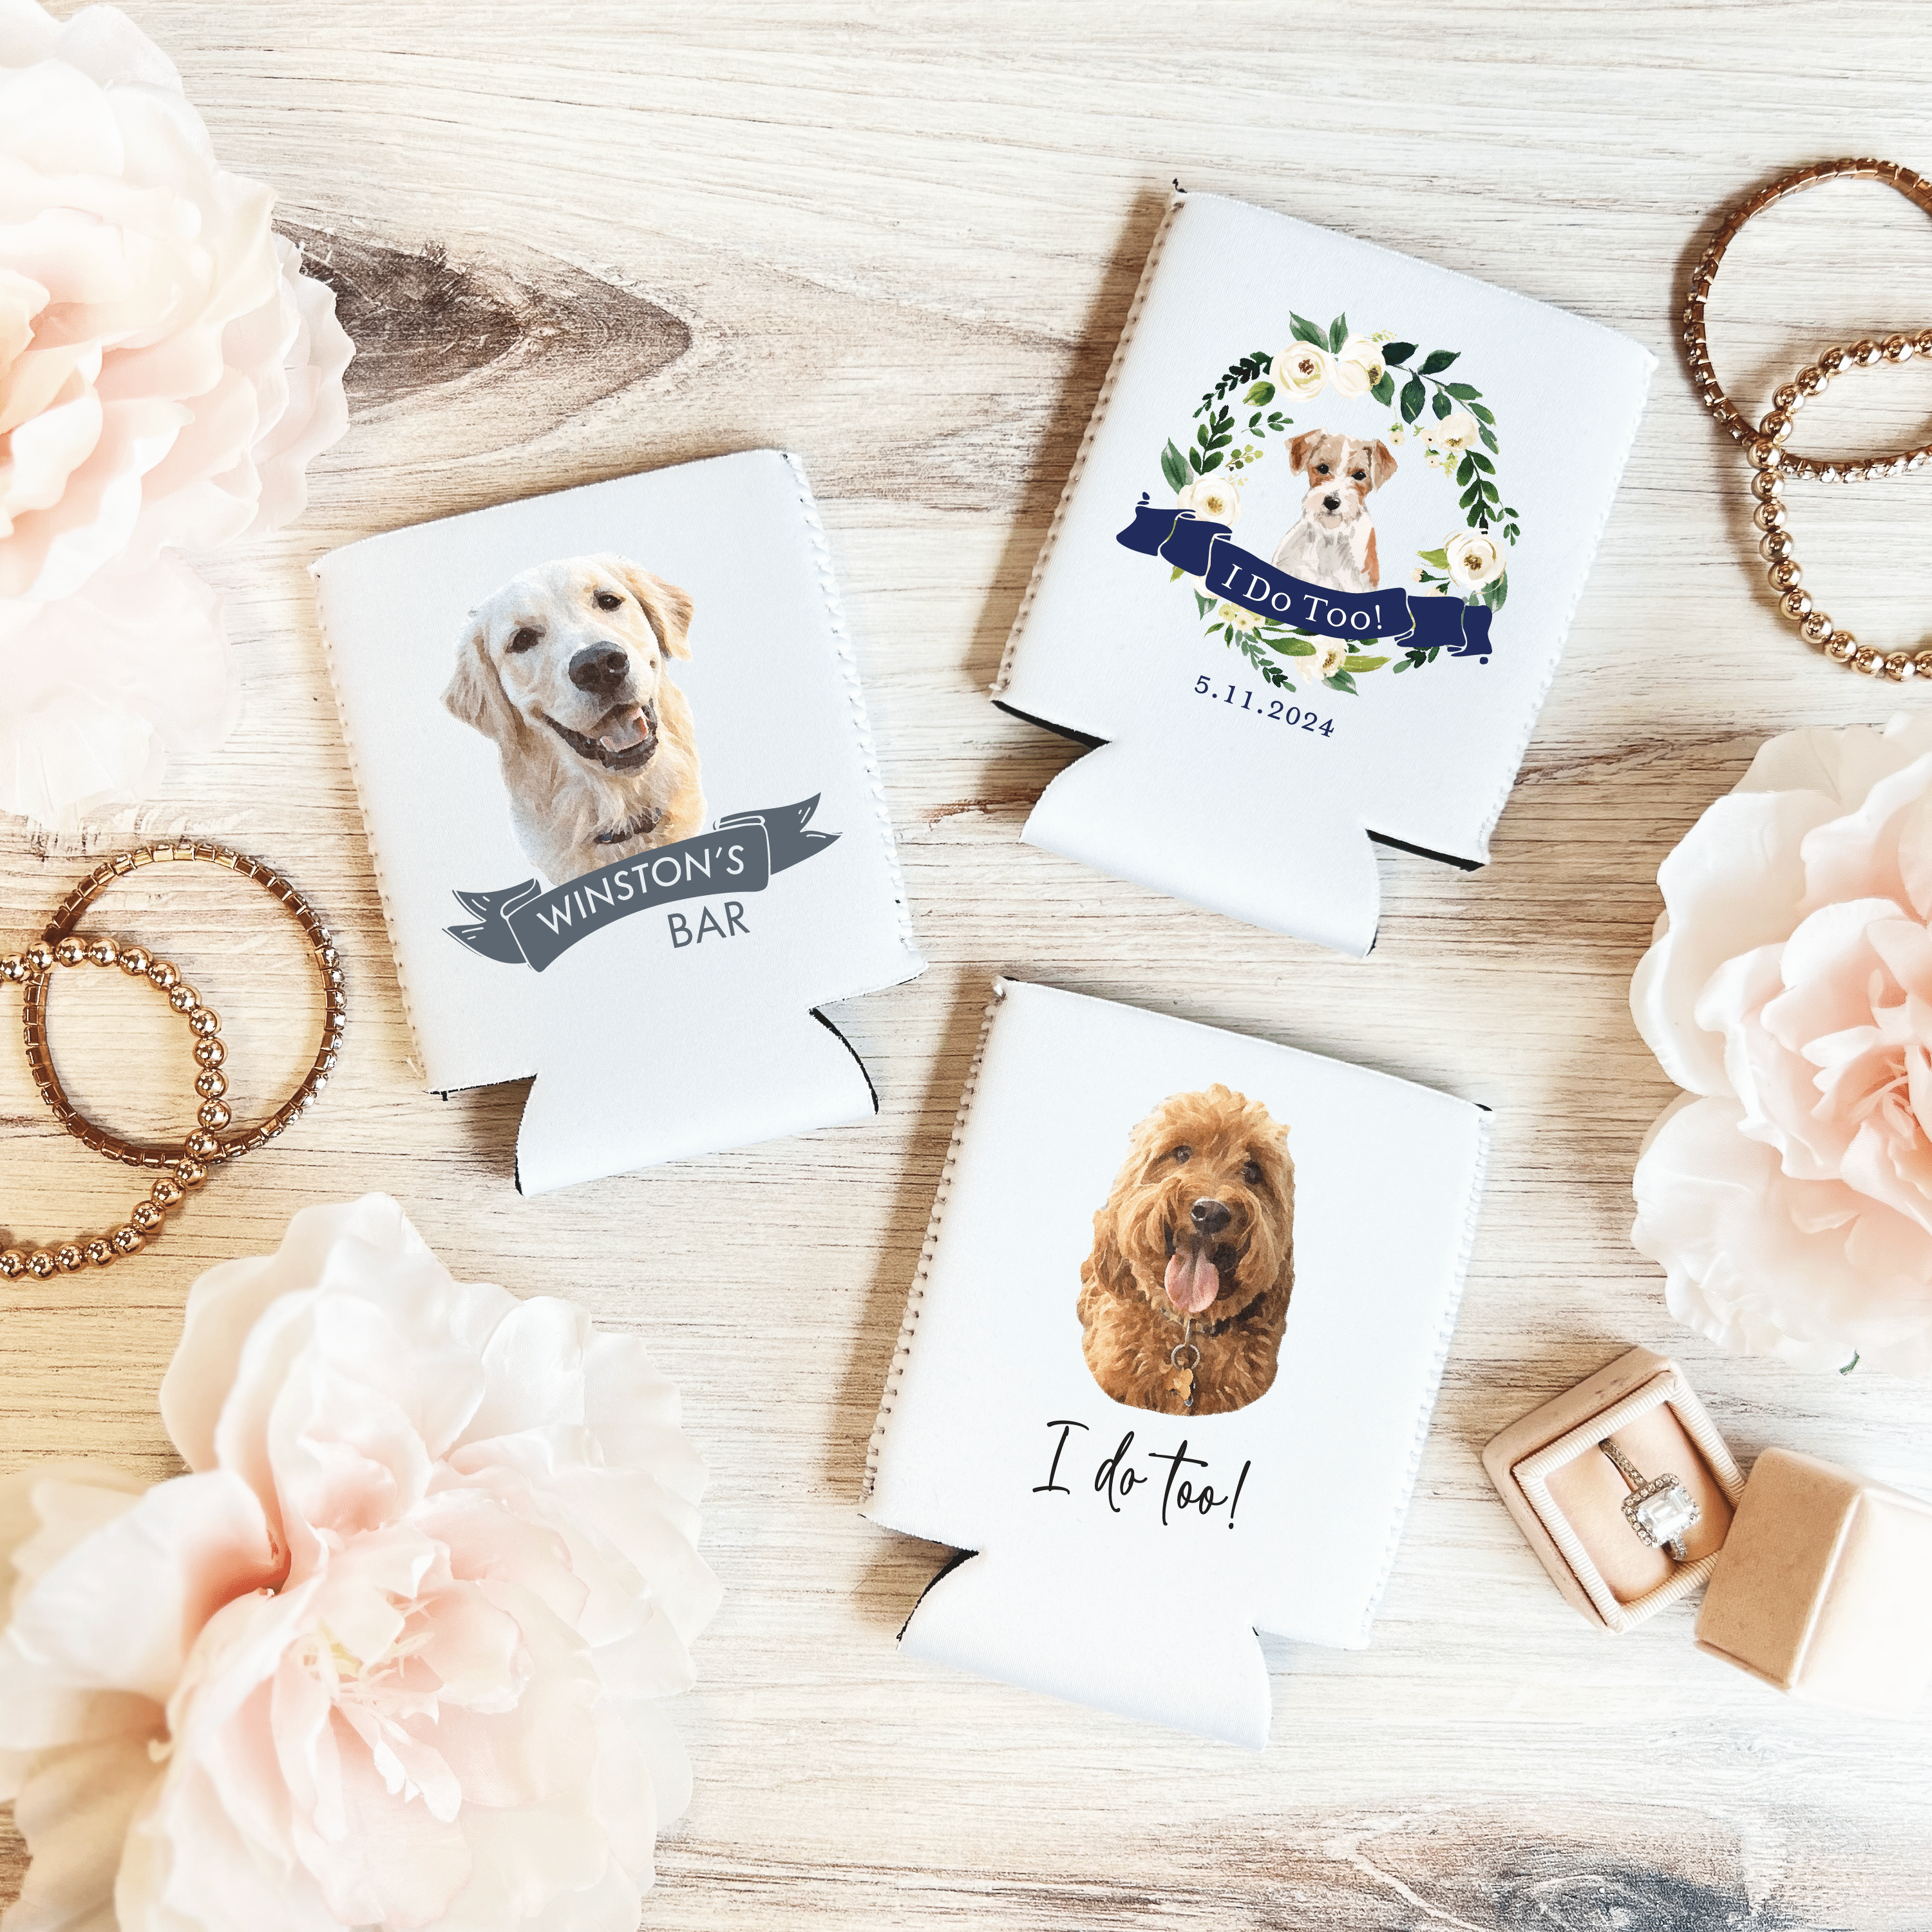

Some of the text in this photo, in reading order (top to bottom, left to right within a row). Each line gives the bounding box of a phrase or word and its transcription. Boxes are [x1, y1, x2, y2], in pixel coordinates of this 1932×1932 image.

[1222, 564, 1383, 630] I Do Too!
[1194, 675, 1334, 737] 5.11.2024
[536, 845, 745, 935] WINSTON'S
[667, 901, 750, 949] BAR
[1032, 1420, 1251, 1530] I do too!
